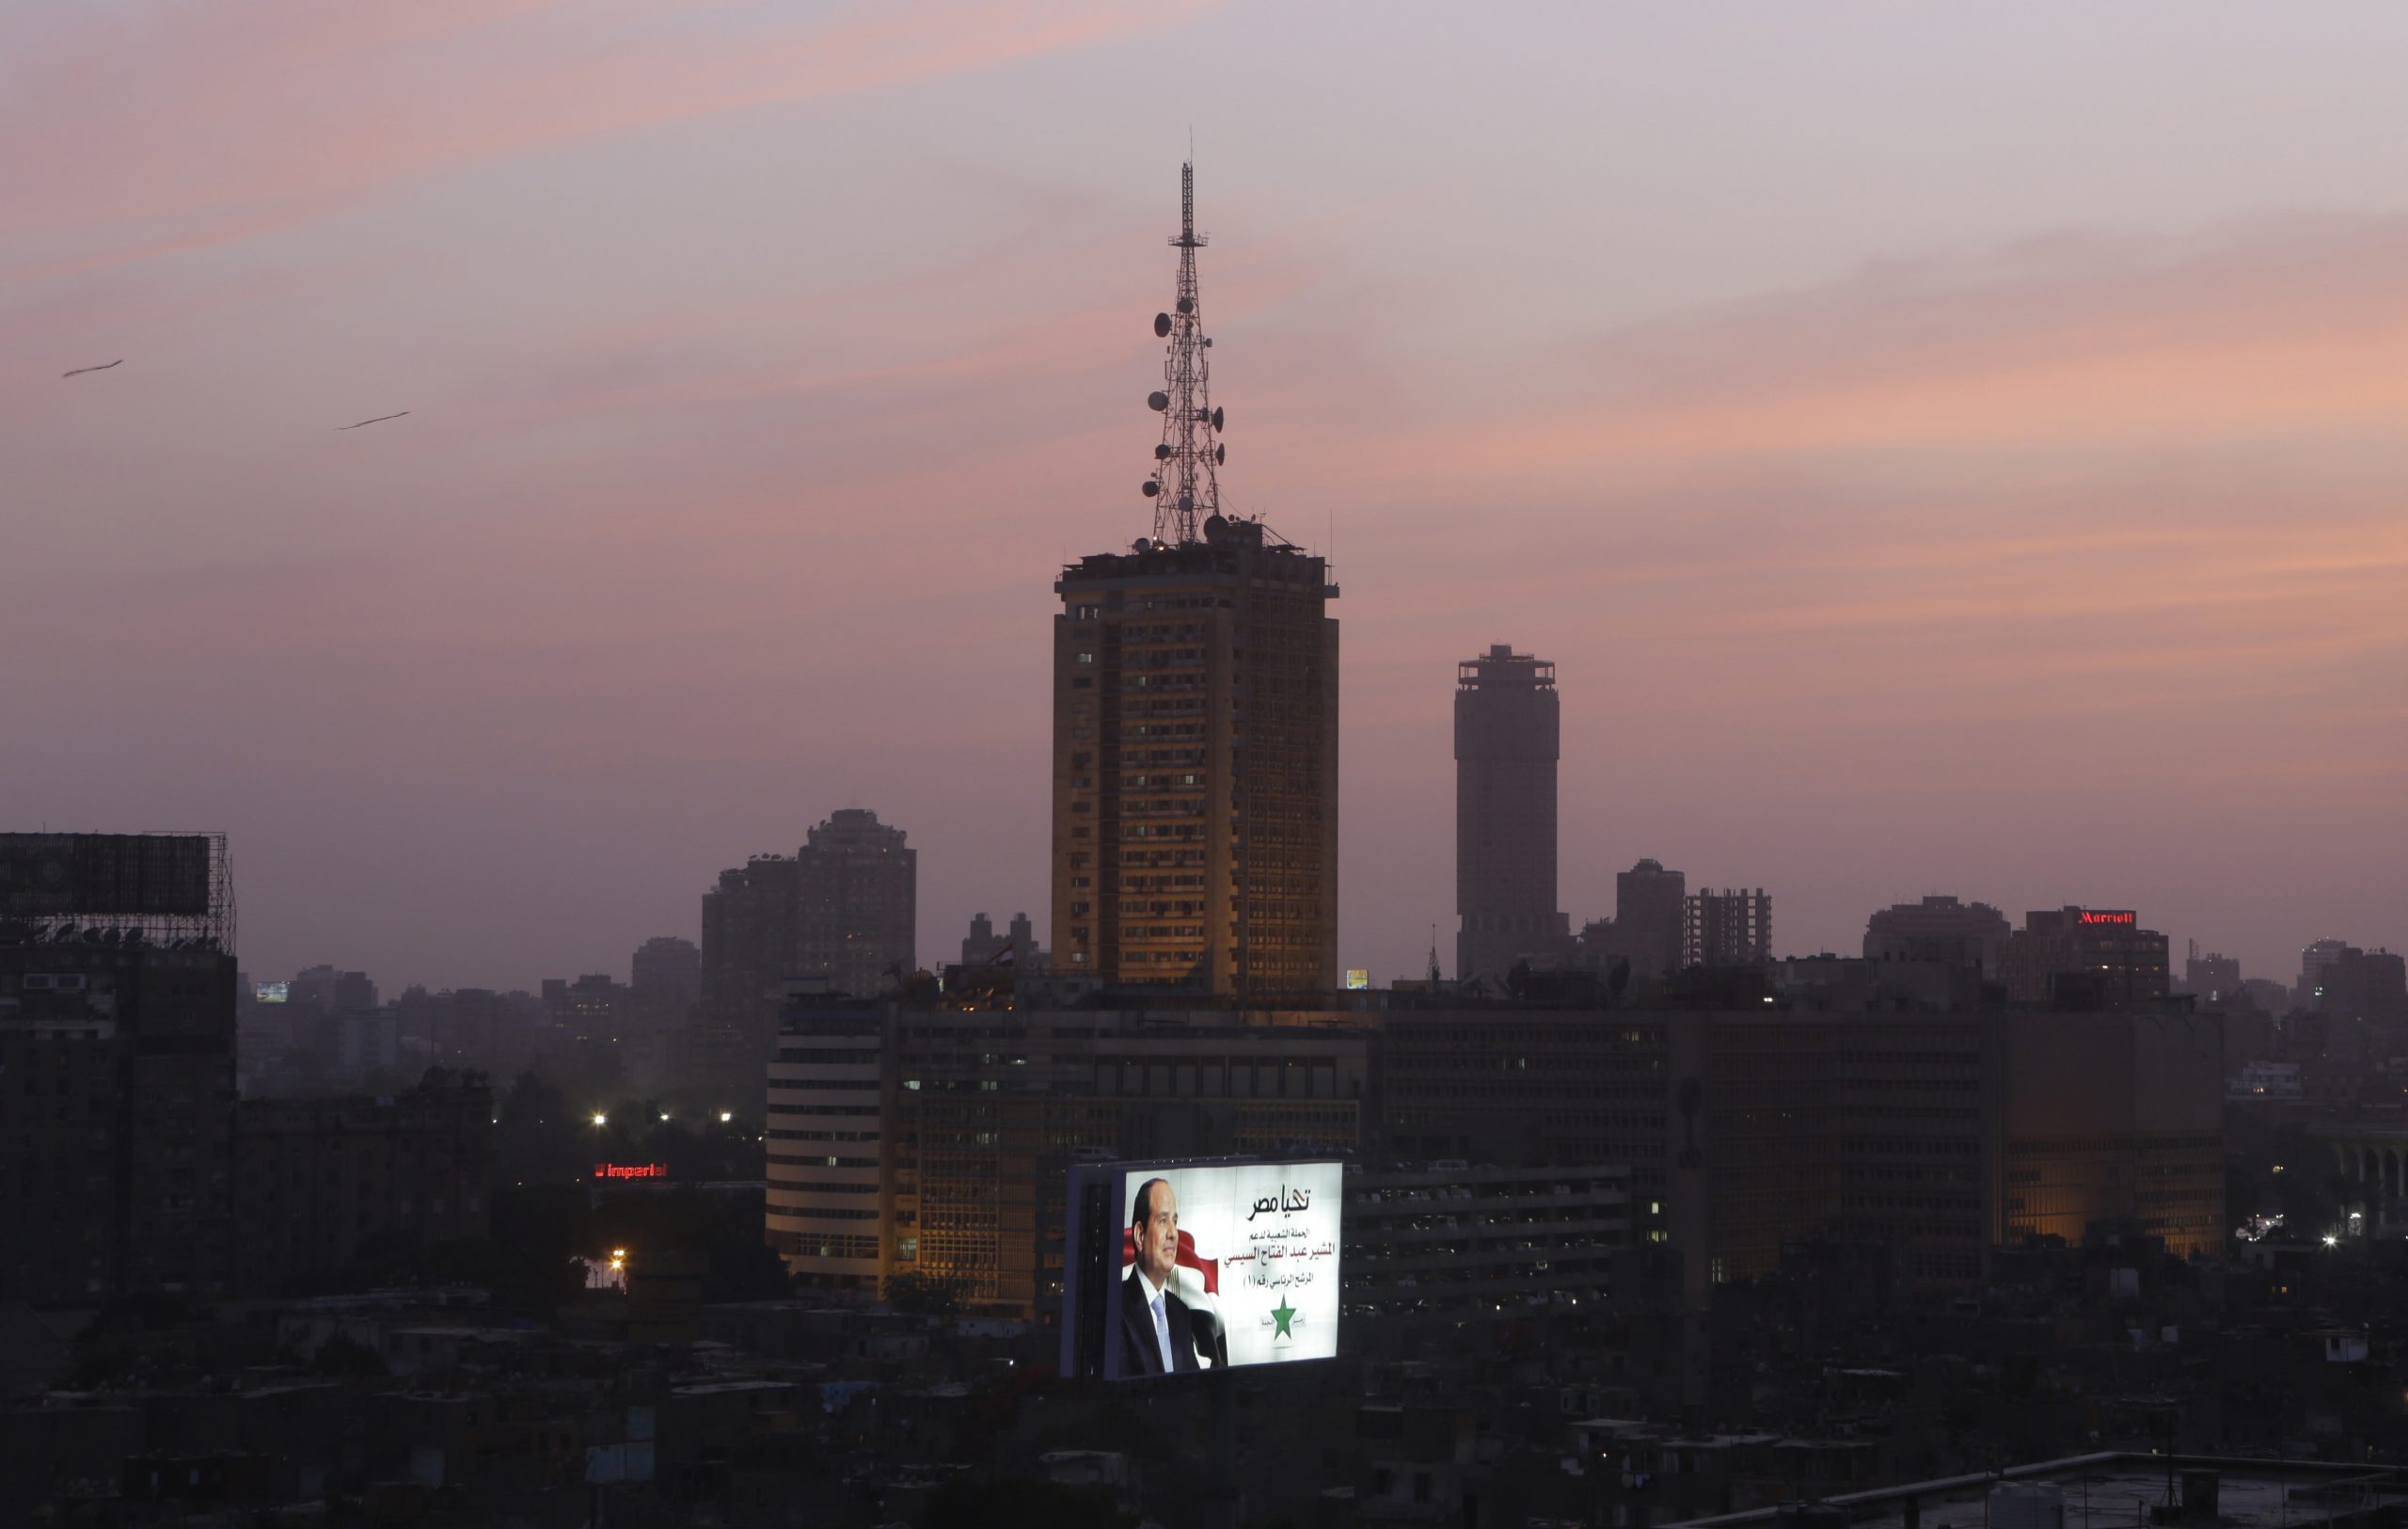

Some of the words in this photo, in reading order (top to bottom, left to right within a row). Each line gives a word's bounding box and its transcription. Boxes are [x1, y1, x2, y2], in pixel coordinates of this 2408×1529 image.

[1245, 1196, 1279, 1222] مصر
[1281, 1183, 1311, 1218] تحيا
[1249, 1231, 1266, 1243] لدعم
[1267, 1229, 1291, 1243] الشعبية
[1291, 1228, 1310, 1239] الحملة
[1224, 1245, 1260, 1268] السيسي
[1260, 1244, 1288, 1266] الفتاح
[1290, 1246, 1307, 1263] عبد
[1309, 1241, 1335, 1261] المشير
[1256, 1274, 1269, 1288] رقم
